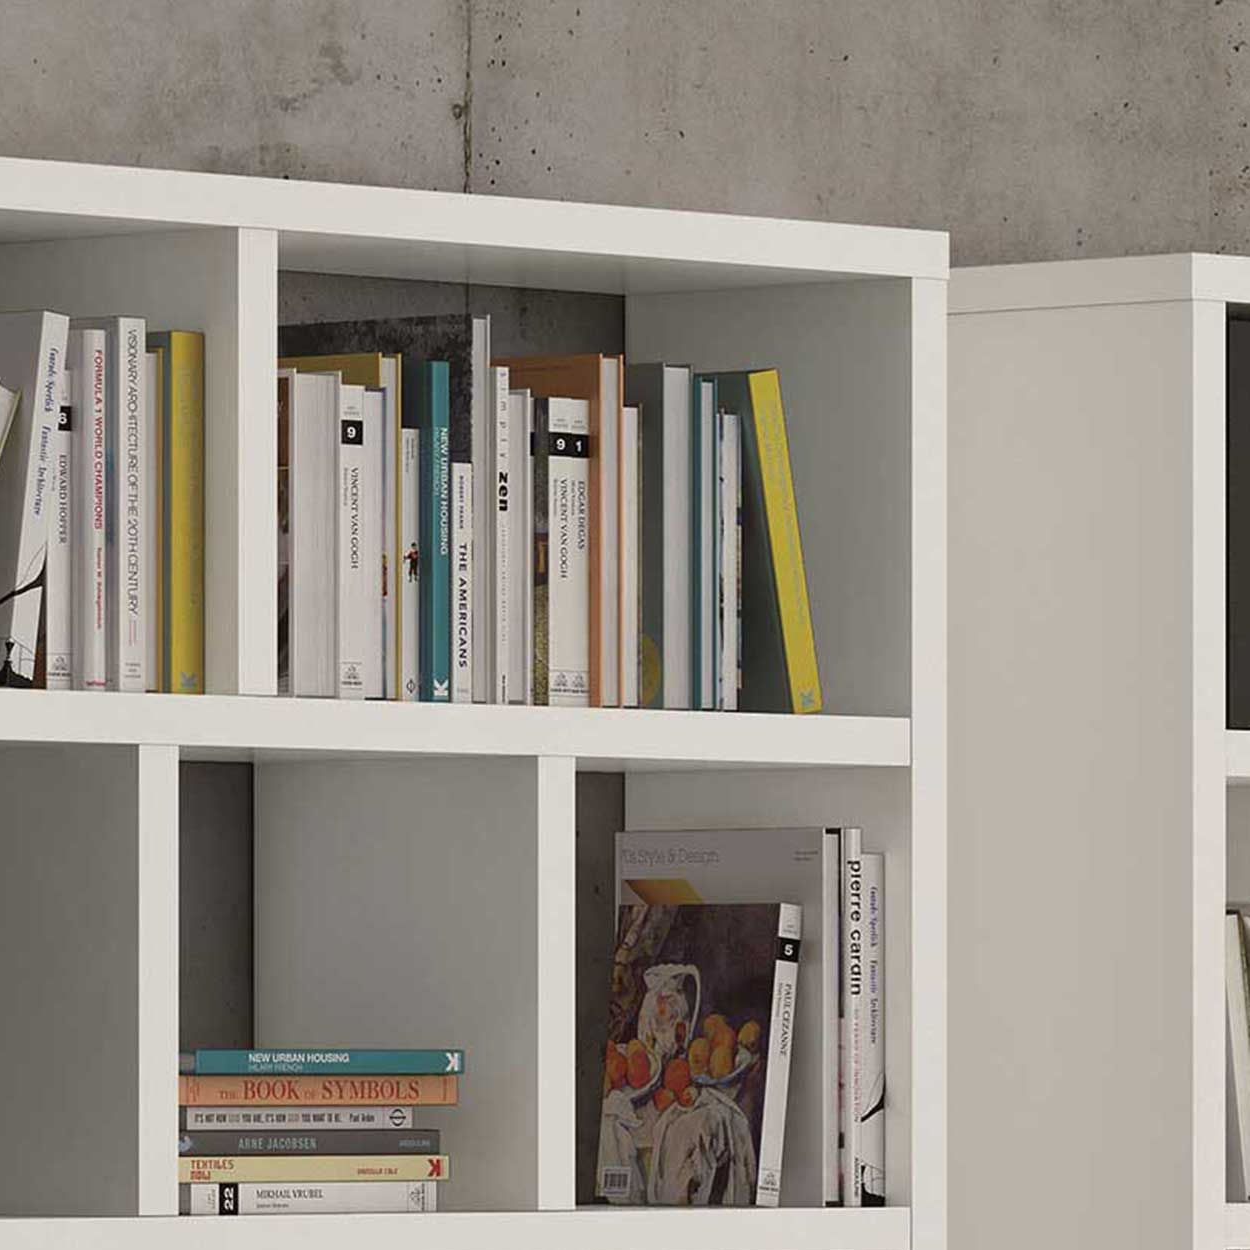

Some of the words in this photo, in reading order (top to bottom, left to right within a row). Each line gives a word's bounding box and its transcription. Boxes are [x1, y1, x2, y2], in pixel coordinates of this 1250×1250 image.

[128, 330, 139, 384] VISIONARY
[95, 349, 103, 404] FORMULA
[95, 416, 103, 459] WORLD
[128, 386, 139, 474] ARCHITECTURE
[347, 426, 357, 439] 9
[440, 427, 449, 455] NEW
[556, 440, 566, 451] 9
[576, 440, 582, 452] 1
[59, 454, 67, 500] EDWARD
[128, 475, 139, 491] OF
[351, 467, 359, 513] VINCENT
[440, 457, 449, 499] URBAN
[498, 472, 509, 512] zen
[95, 460, 103, 530] CHAMPIONS
[128, 492, 139, 516] THE
[560, 478, 569, 523] VINCENT
[578, 480, 586, 516] EDGAR
[59, 501, 67, 544] HOPPER
[128, 519, 139, 553] 20TH
[351, 513, 359, 536] VAN
[440, 500, 449, 555] HOUSING
[560, 525, 569, 546] VAN
[578, 517, 586, 550] DEGAS
[351, 537, 359, 569] GOGH
[459, 543, 467, 571] THE
[560, 547, 569, 579] GOGH
[128, 553, 139, 615] CENTURY
[459, 578, 467, 668] AMERICANS
[847, 860, 861, 922] pierre
[784, 944, 794, 957] 5
[850, 929, 862, 996] cardin
[783, 983, 793, 1010] PAUL
[248, 1053, 272, 1063] NEW
[273, 1053, 306, 1063] URBAN
[306, 1053, 350, 1063] HOUSING
[243, 1080, 301, 1101] BOOK
[322, 1080, 420, 1100] SYMBOLS
[238, 1137, 264, 1150] ARNE
[265, 1137, 317, 1150] JACOBSEN
[191, 1159, 234, 1170] TEXTILES
[224, 1187, 235, 1211] 22
[256, 1189, 290, 1199] MIKHAIL
[291, 1189, 323, 1198] VRUBEL
